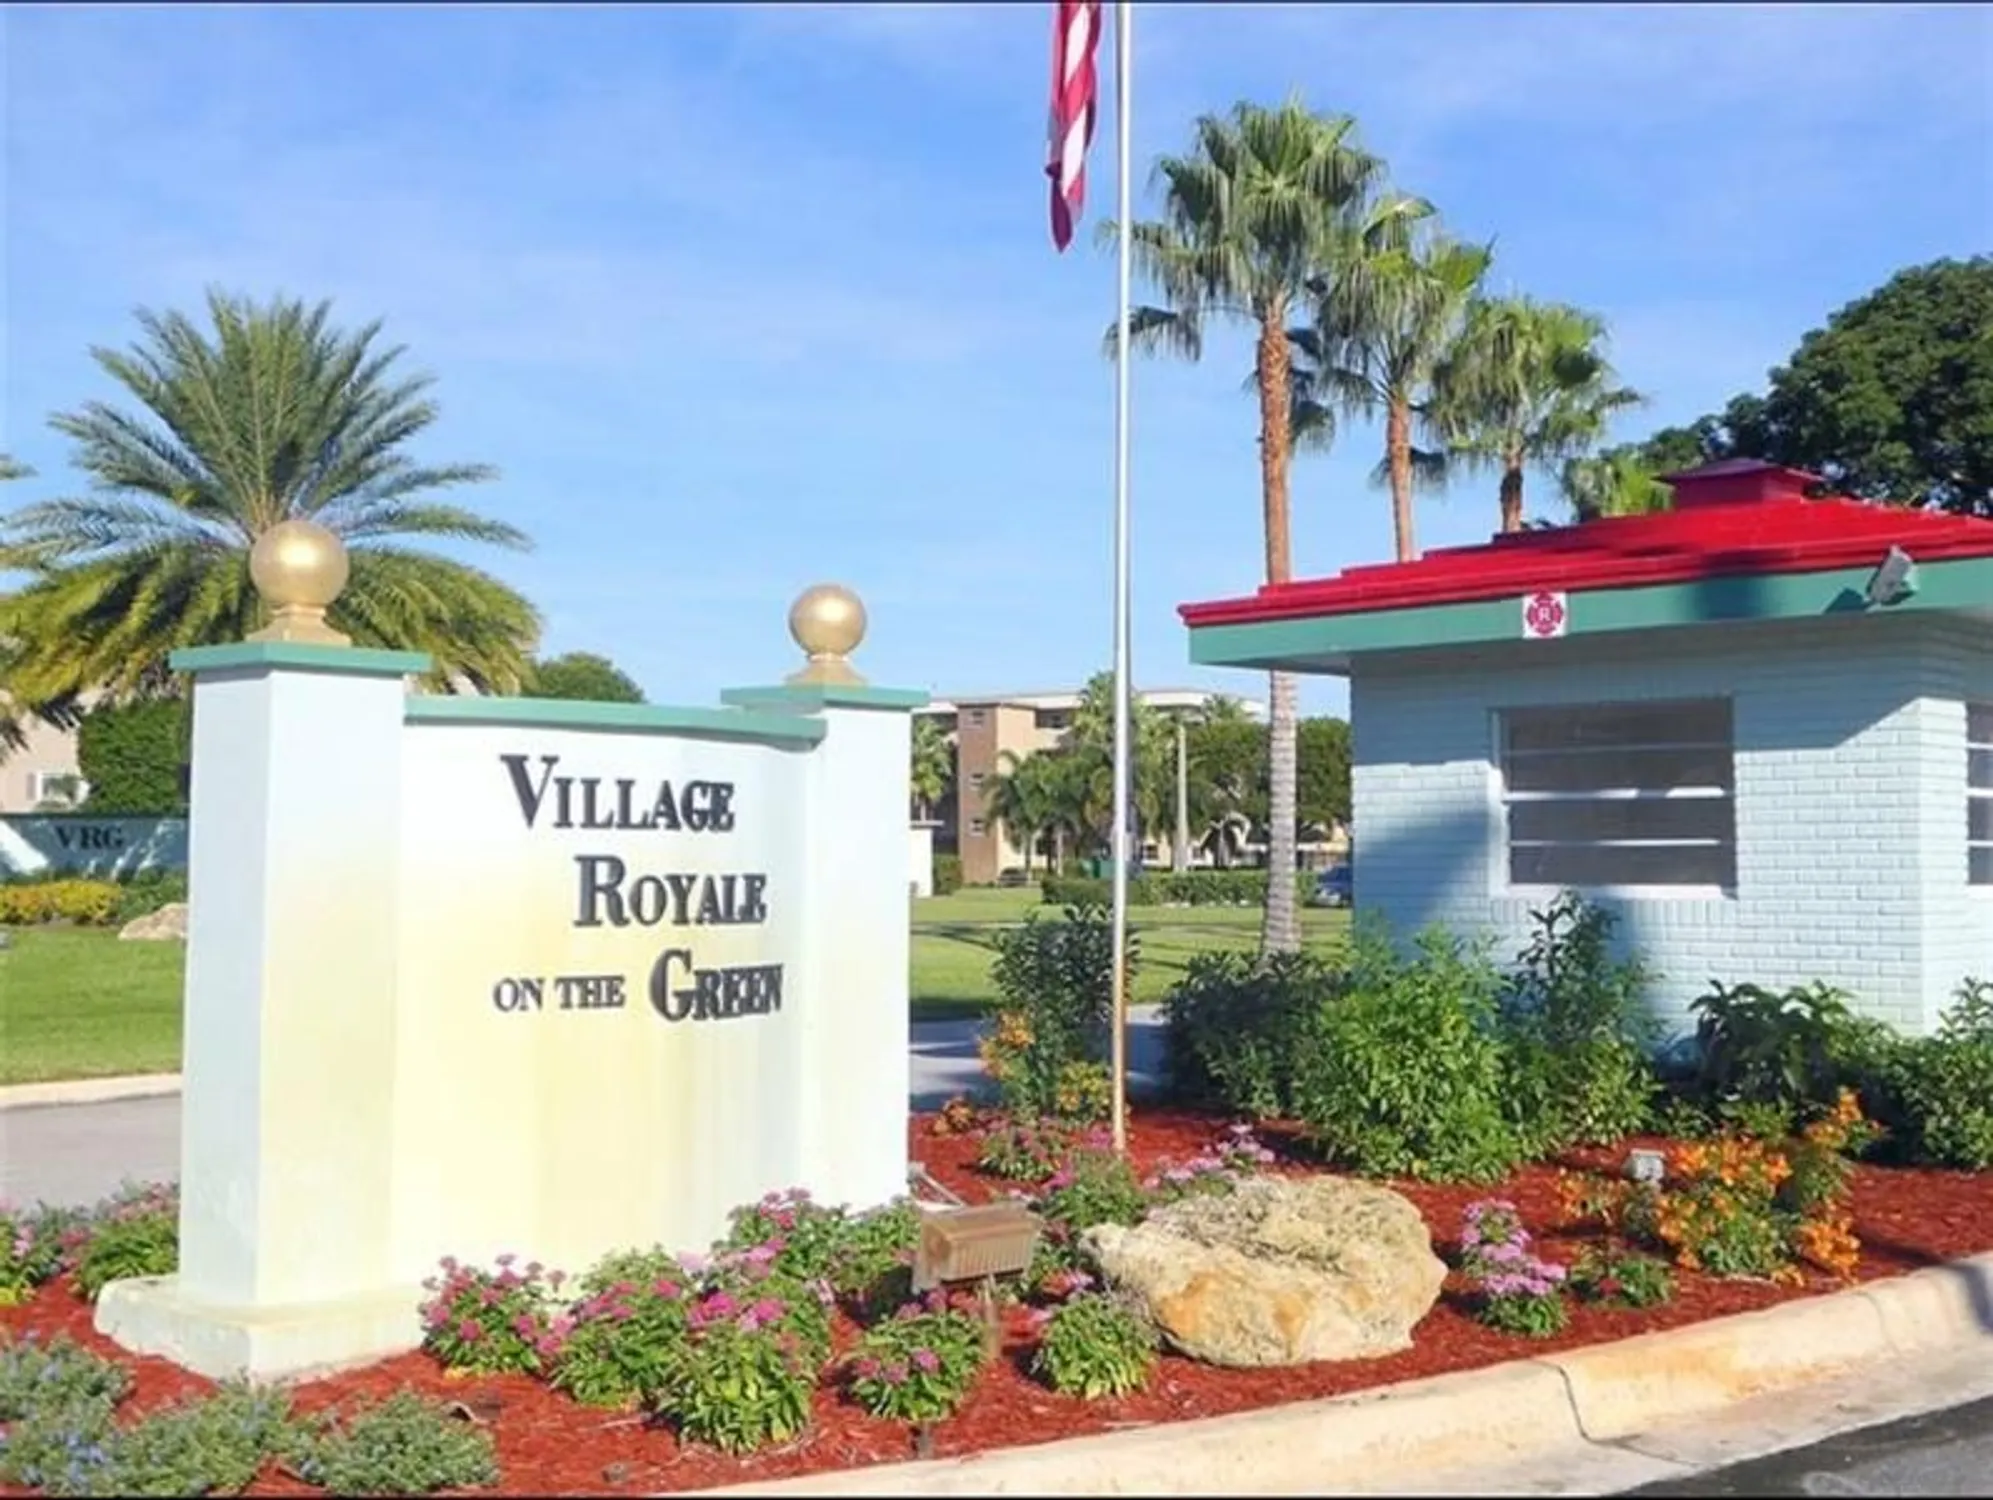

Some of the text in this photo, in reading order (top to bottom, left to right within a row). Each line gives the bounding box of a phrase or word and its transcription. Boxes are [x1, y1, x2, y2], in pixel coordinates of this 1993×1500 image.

[499, 754, 735, 833] VILLAGE
[54, 826, 123, 848] VRG
[573, 855, 768, 927] ROYALE
[493, 948, 784, 1022] ON THE GREEN
